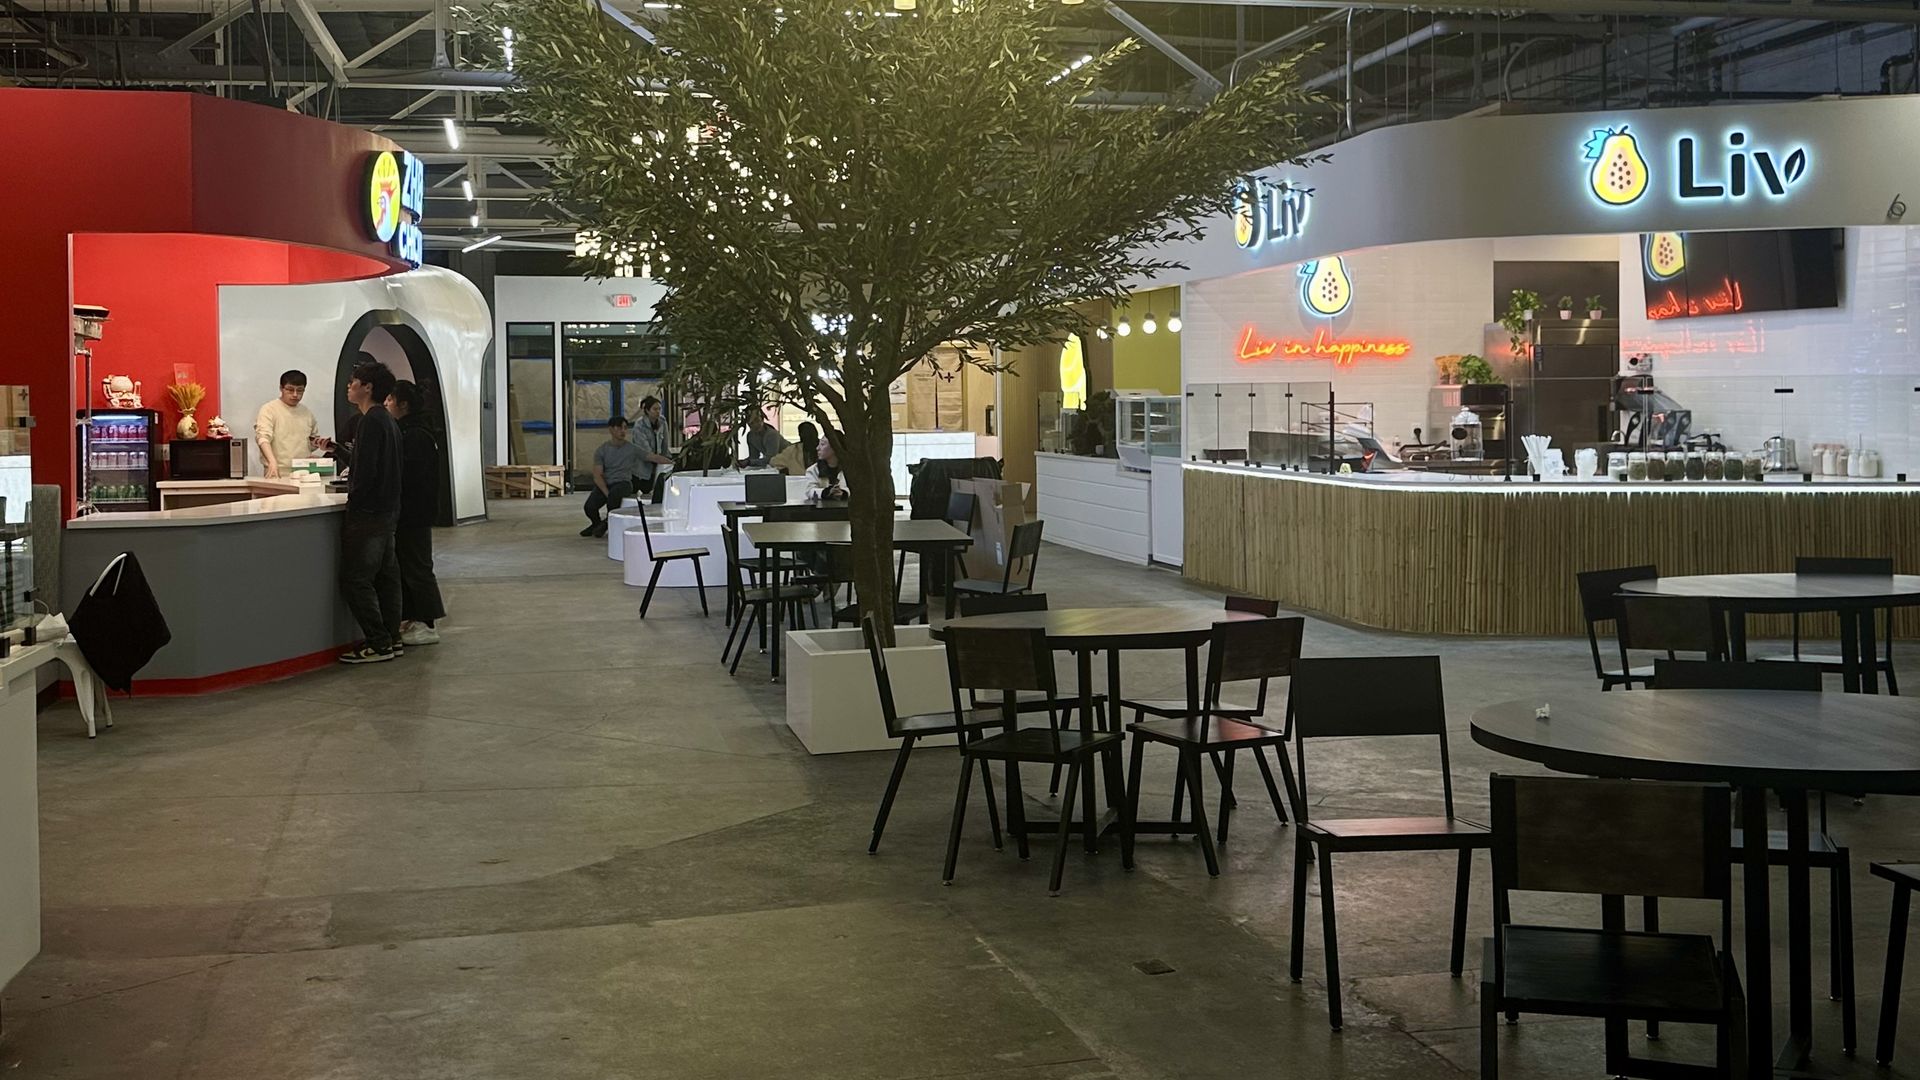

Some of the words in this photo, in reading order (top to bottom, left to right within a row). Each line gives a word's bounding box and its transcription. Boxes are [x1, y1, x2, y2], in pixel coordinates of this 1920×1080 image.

[1678, 131, 1806, 198] Liv
[1239, 327, 1277, 359] Liv
[1284, 339, 1311, 355] in
[1314, 330, 1410, 364] happiness
